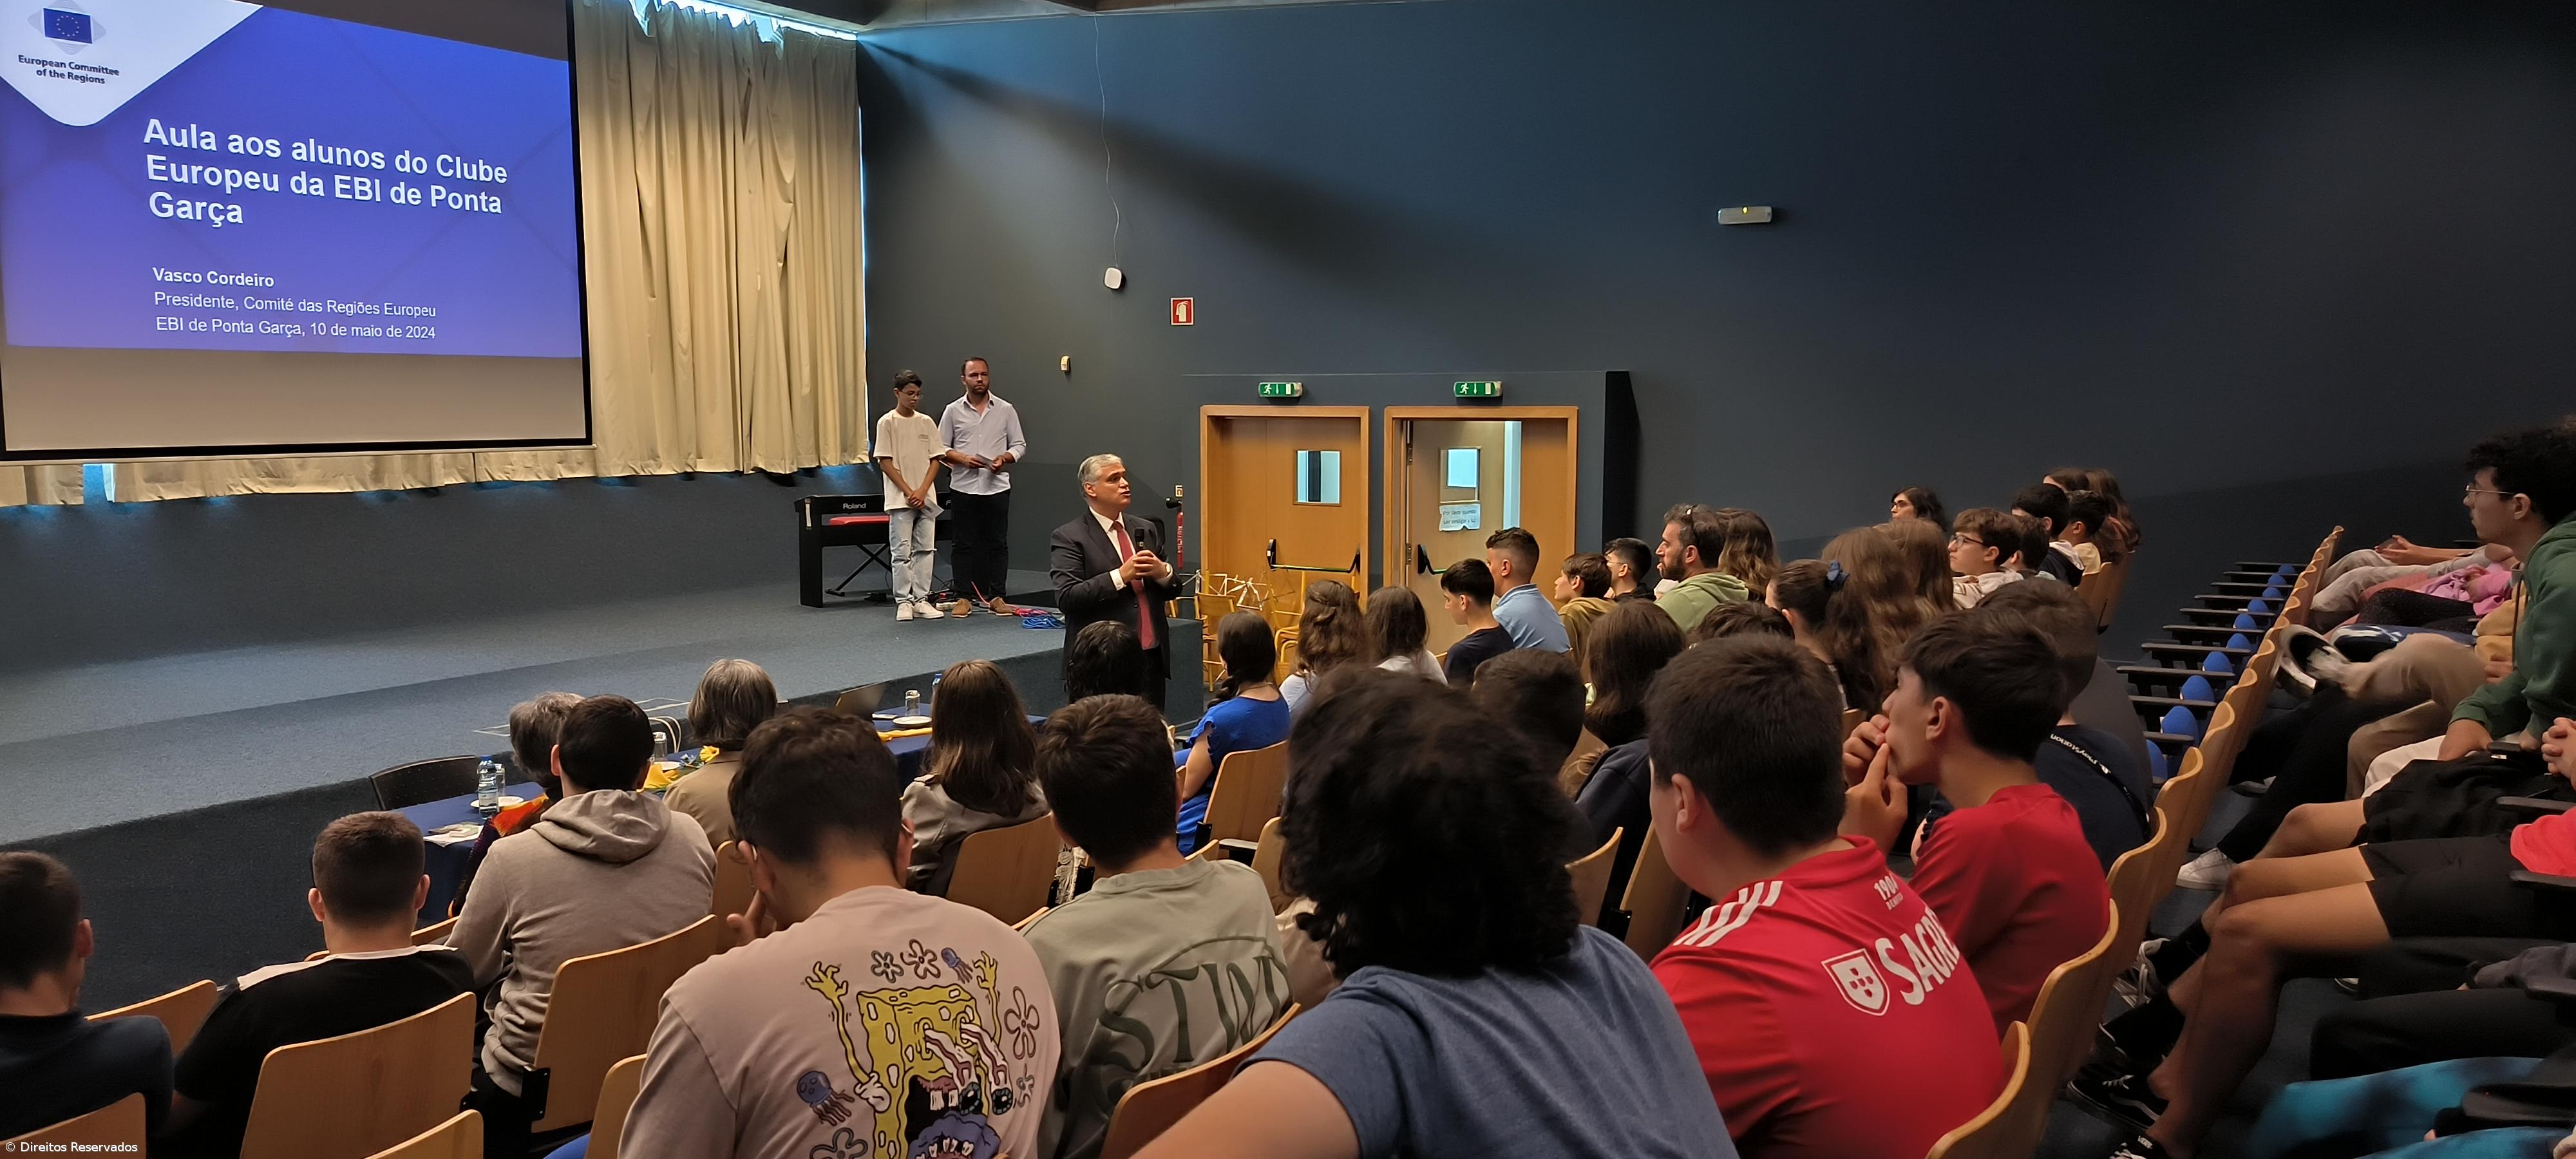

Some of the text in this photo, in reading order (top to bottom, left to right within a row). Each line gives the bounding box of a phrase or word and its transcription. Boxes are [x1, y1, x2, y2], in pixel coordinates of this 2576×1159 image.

[18, 54, 120, 76] European Committee
[36, 68, 105, 84] of the Regions
[143, 118, 507, 184] Aula aos alunos do Clube
[146, 154, 502, 214] Europeu da EBI de Ponta
[149, 191, 243, 228] Garça
[152, 267, 274, 287] Vasco Cordeiro
[154, 291, 436, 319] Presidente, Comité das Regiões Europeu
[156, 316, 436, 339] EBI de Ponta Garça, 10 de maio de 2024
